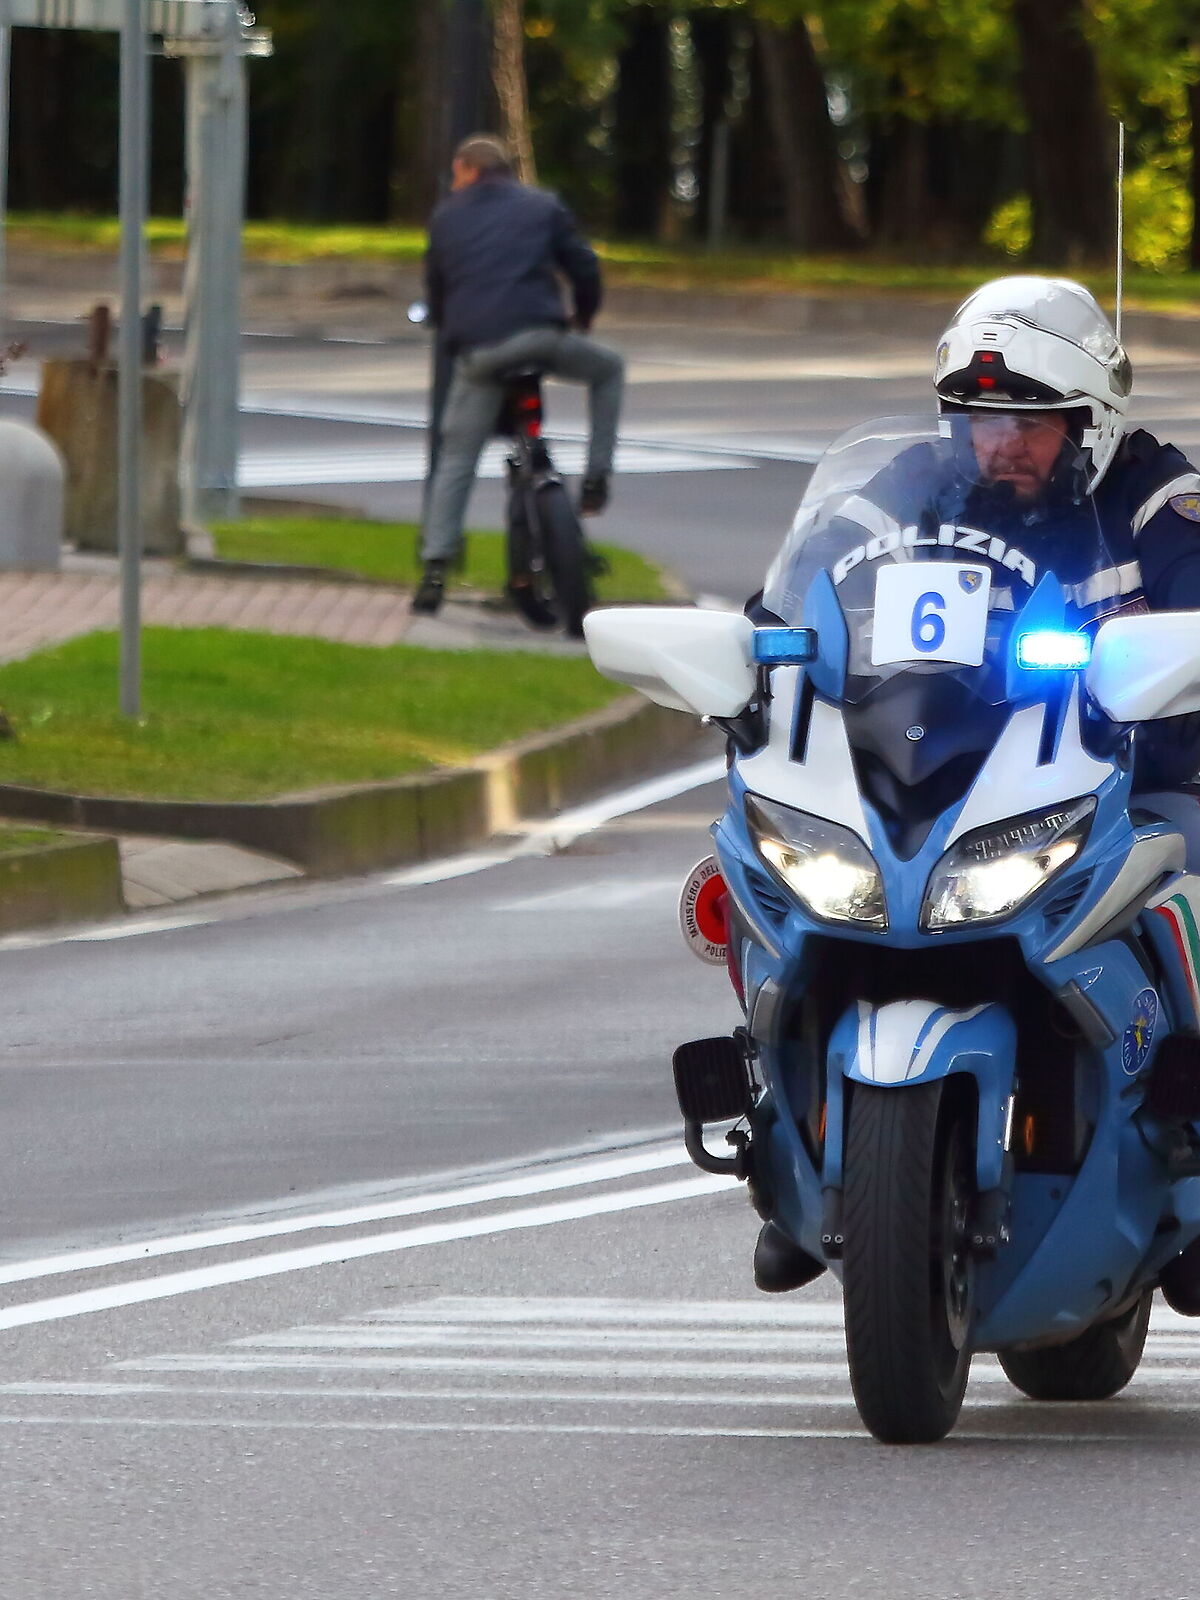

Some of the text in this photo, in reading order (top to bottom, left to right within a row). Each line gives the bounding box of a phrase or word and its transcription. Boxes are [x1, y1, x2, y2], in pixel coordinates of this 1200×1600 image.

[832, 524, 1036, 587] POLIZIA
[910, 591, 946, 653] 6
[685, 880, 700, 938] MINISTERO
[705, 944, 726, 957] POLIZ
